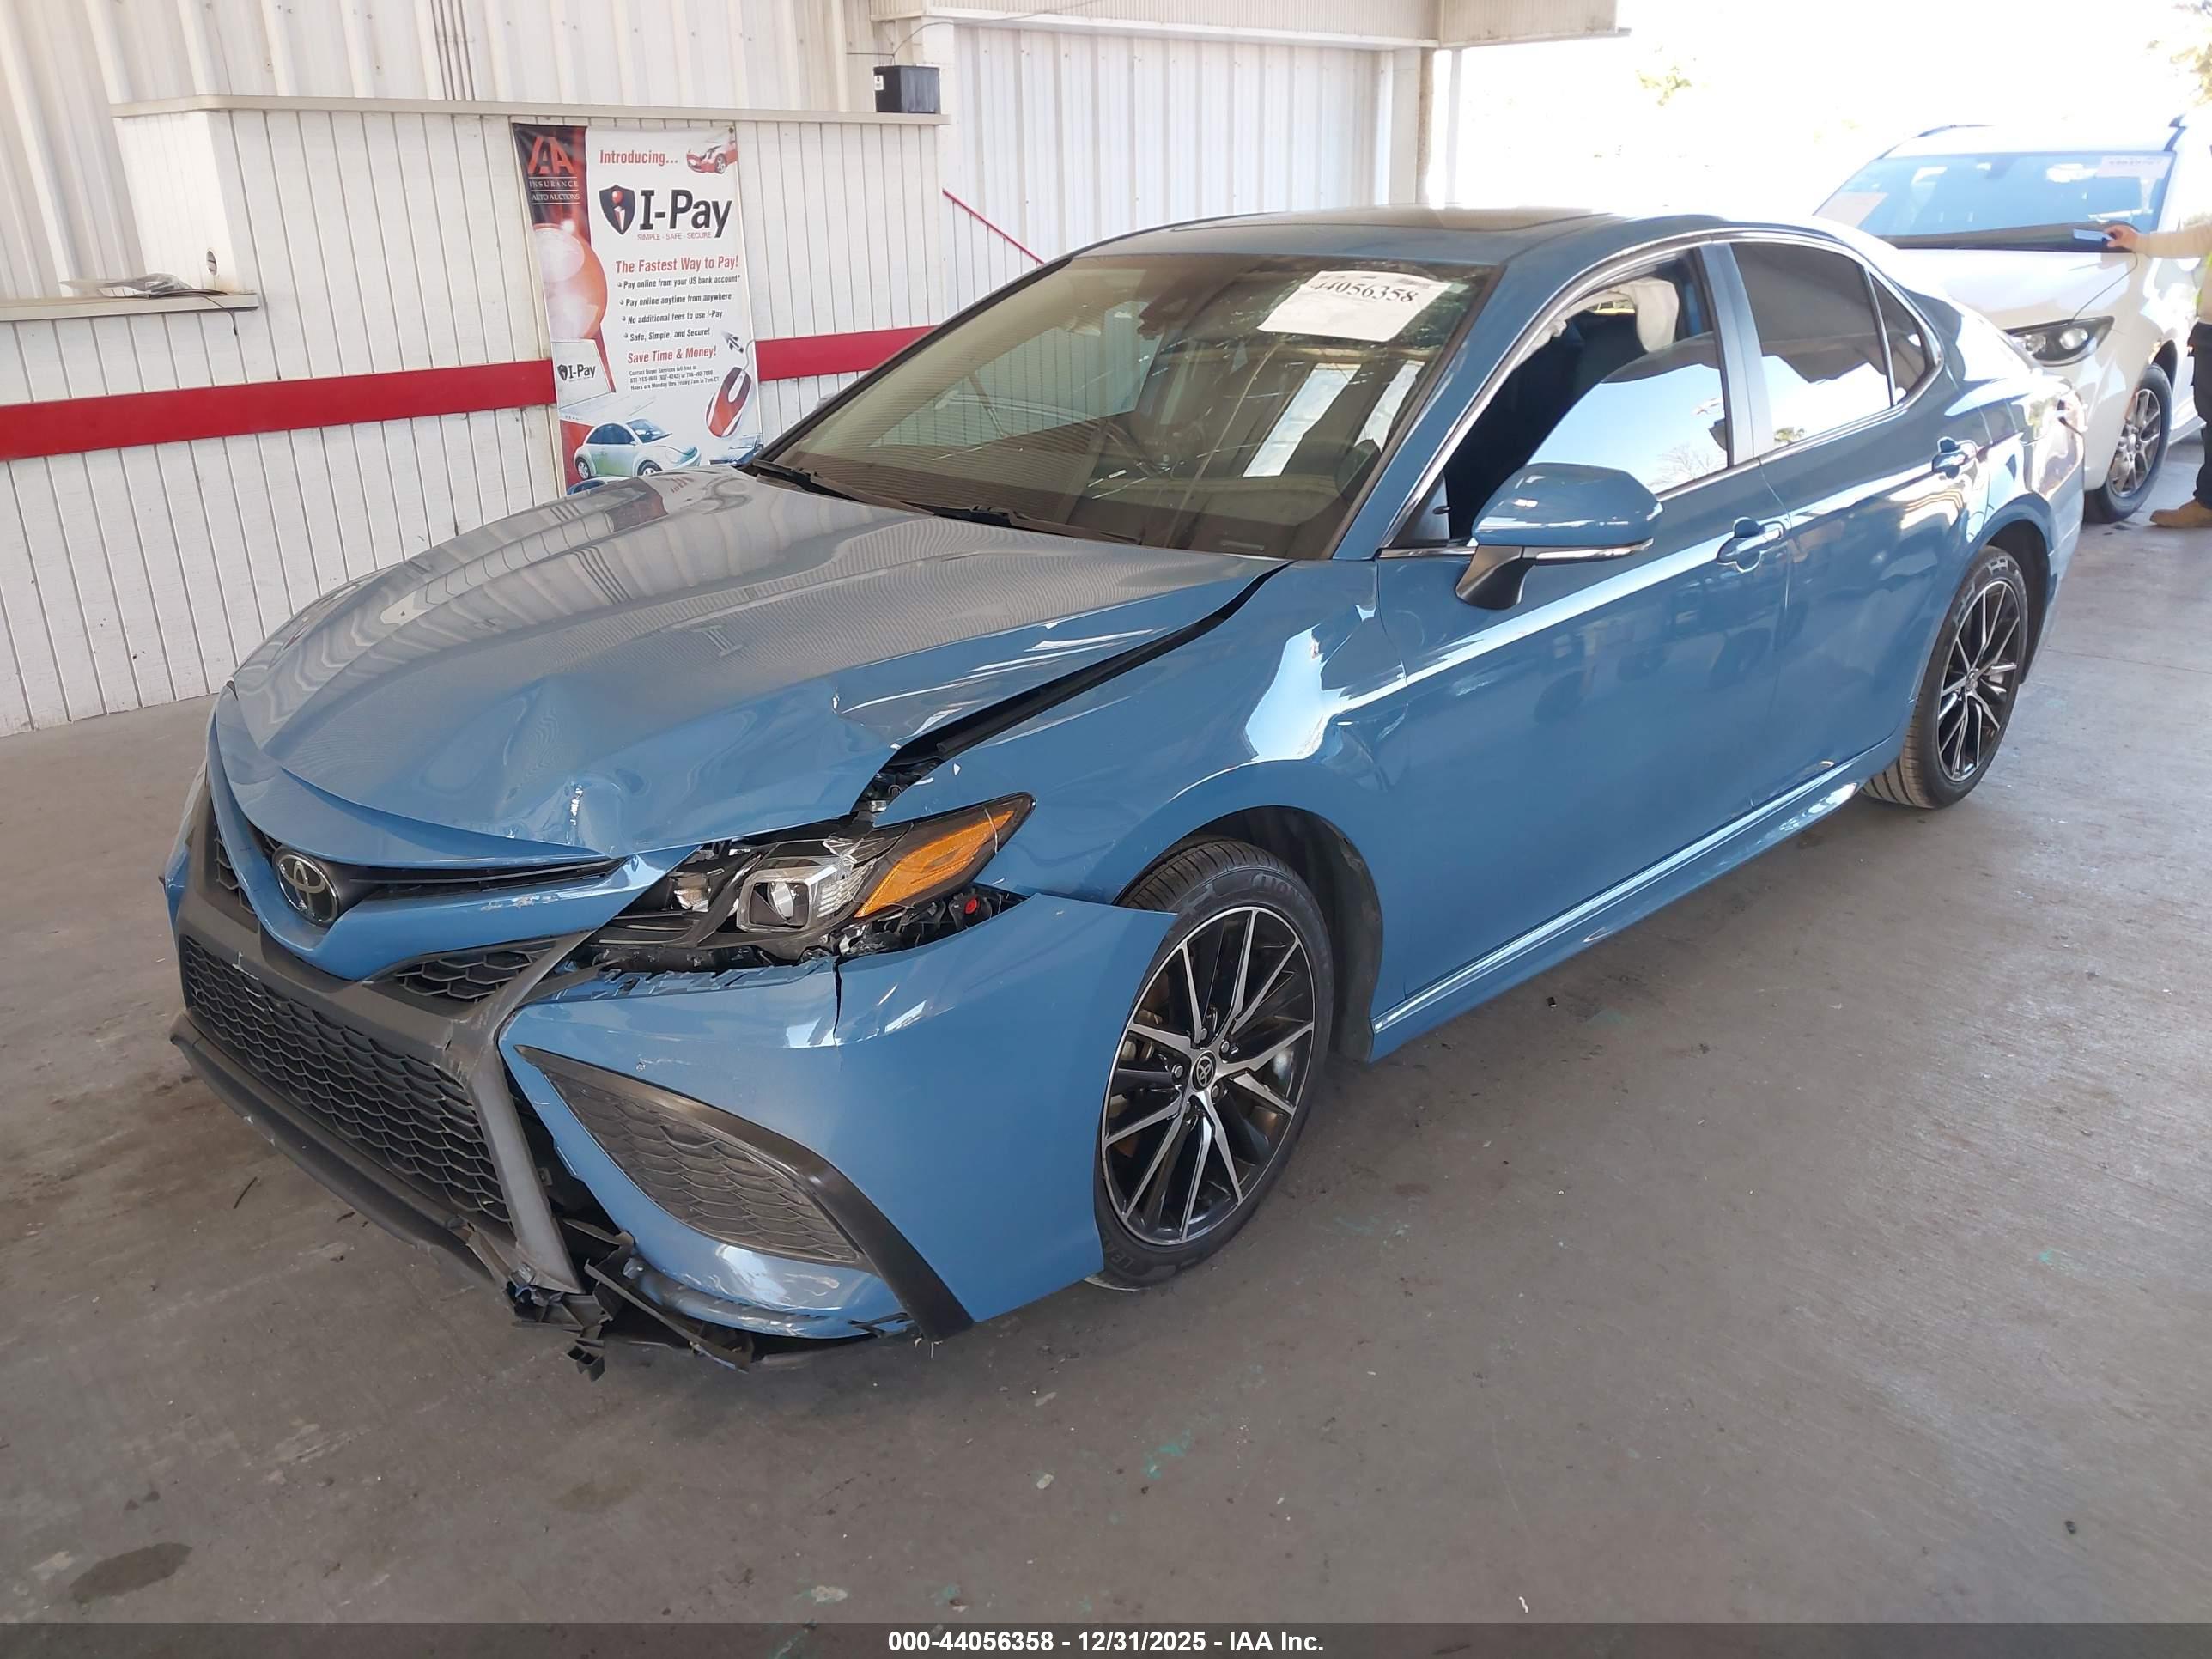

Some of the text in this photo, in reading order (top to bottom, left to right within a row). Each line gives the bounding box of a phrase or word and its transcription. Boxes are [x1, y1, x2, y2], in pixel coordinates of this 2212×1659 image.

[528, 137, 576, 174] IAA
[599, 149, 678, 167] Introducing...
[639, 189, 733, 239] I-Pay
[686, 231, 712, 240] SECURE
[616, 255, 739, 274] The Fastest Way to Pay!
[623, 280, 635, 290] Pay
[636, 279, 656, 288] online
[658, 278, 672, 287] from
[673, 278, 687, 288] your
[689, 276, 696, 285] US
[698, 276, 712, 284] bank
[625, 298, 637, 308] Pay
[639, 297, 659, 306] online
[660, 295, 686, 305] anytime
[702, 293, 732, 302] anywhere
[628, 316, 636, 325] No
[637, 313, 670, 324] additional
[686, 312, 693, 320] to
[707, 310, 723, 319] I-Pay
[629, 333, 647, 342] Safe,
[648, 331, 672, 341] Simple,
[686, 327, 710, 337] Secure!
[627, 345, 717, 363] Save Time & Money!
[568, 364, 596, 379] I-Pay
